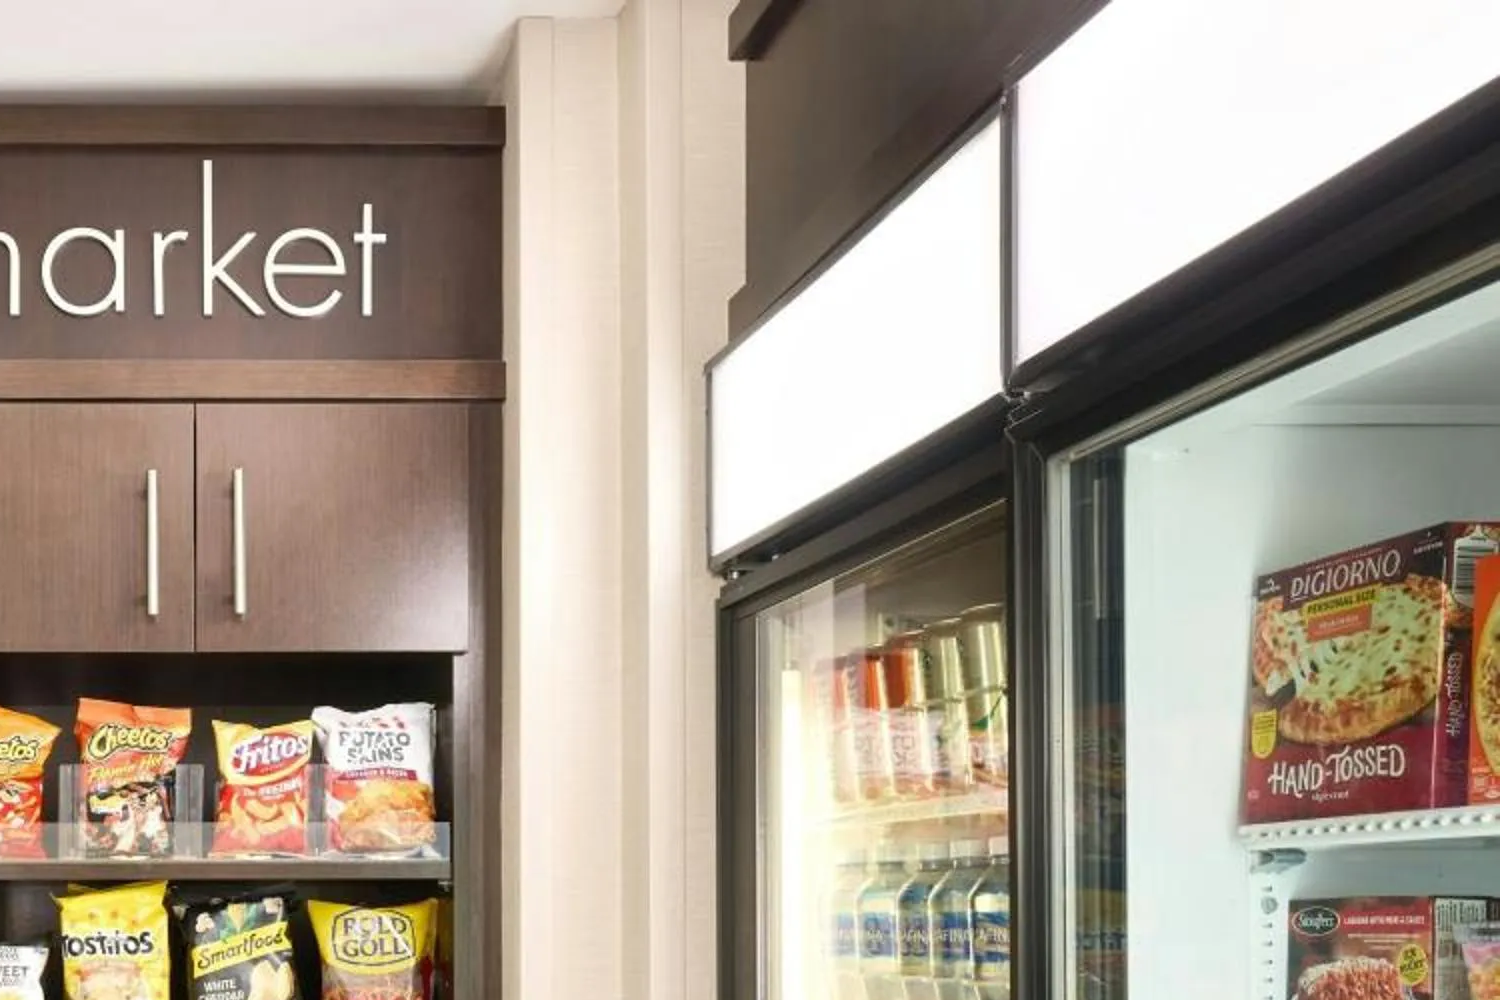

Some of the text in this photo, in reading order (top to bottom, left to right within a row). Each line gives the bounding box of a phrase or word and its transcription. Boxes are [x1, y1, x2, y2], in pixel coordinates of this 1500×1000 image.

[88, 725, 172, 758] Cheetos
[1268, 743, 1405, 798] HAND-TOSSED
[197, 927, 284, 969] Smartfood
